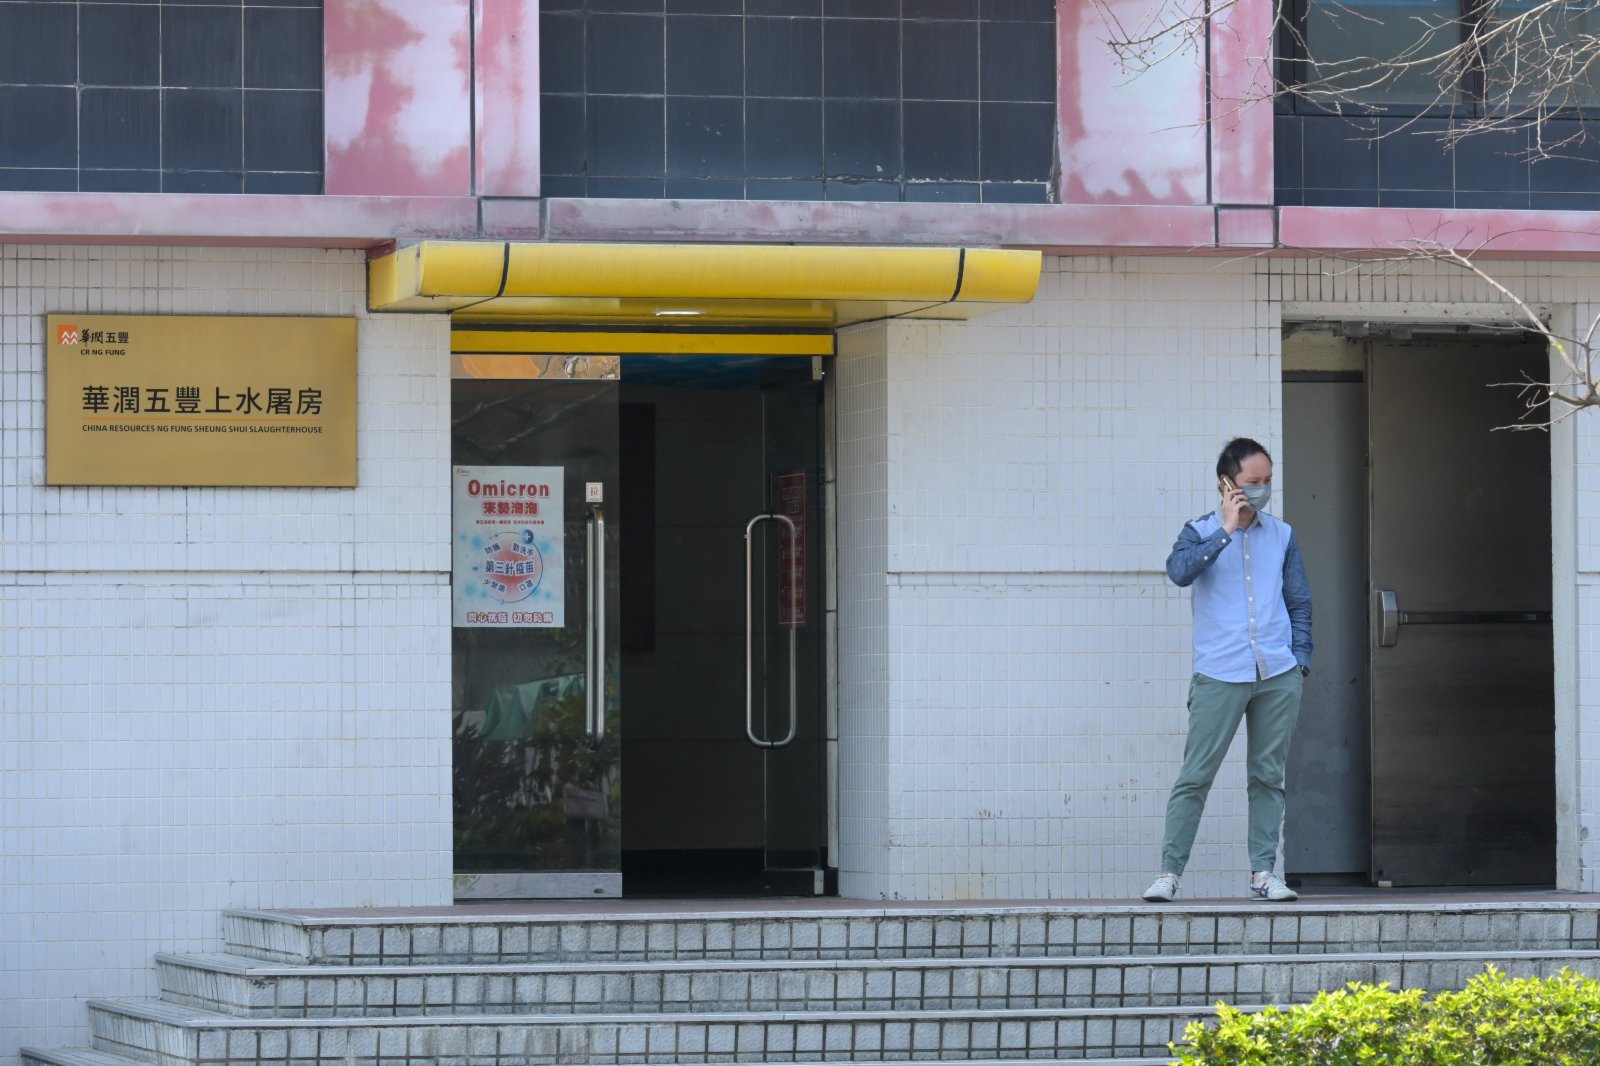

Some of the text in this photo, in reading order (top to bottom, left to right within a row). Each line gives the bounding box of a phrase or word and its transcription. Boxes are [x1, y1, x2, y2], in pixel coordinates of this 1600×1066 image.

[79, 328, 130, 347] 華潤五豐
[82, 385, 323, 415] 華潤五豐上水屠房
[82, 424, 108, 432] CHINA
[156, 425, 169, 433] NG
[170, 425, 193, 433] FUNG
[194, 425, 227, 433] SHEUNG
[229, 425, 248, 433] SHUI
[249, 425, 323, 434] SLAUGHTERHOUSE
[467, 479, 550, 498] Omicron
[485, 559, 534, 575] 第三針疫苗
